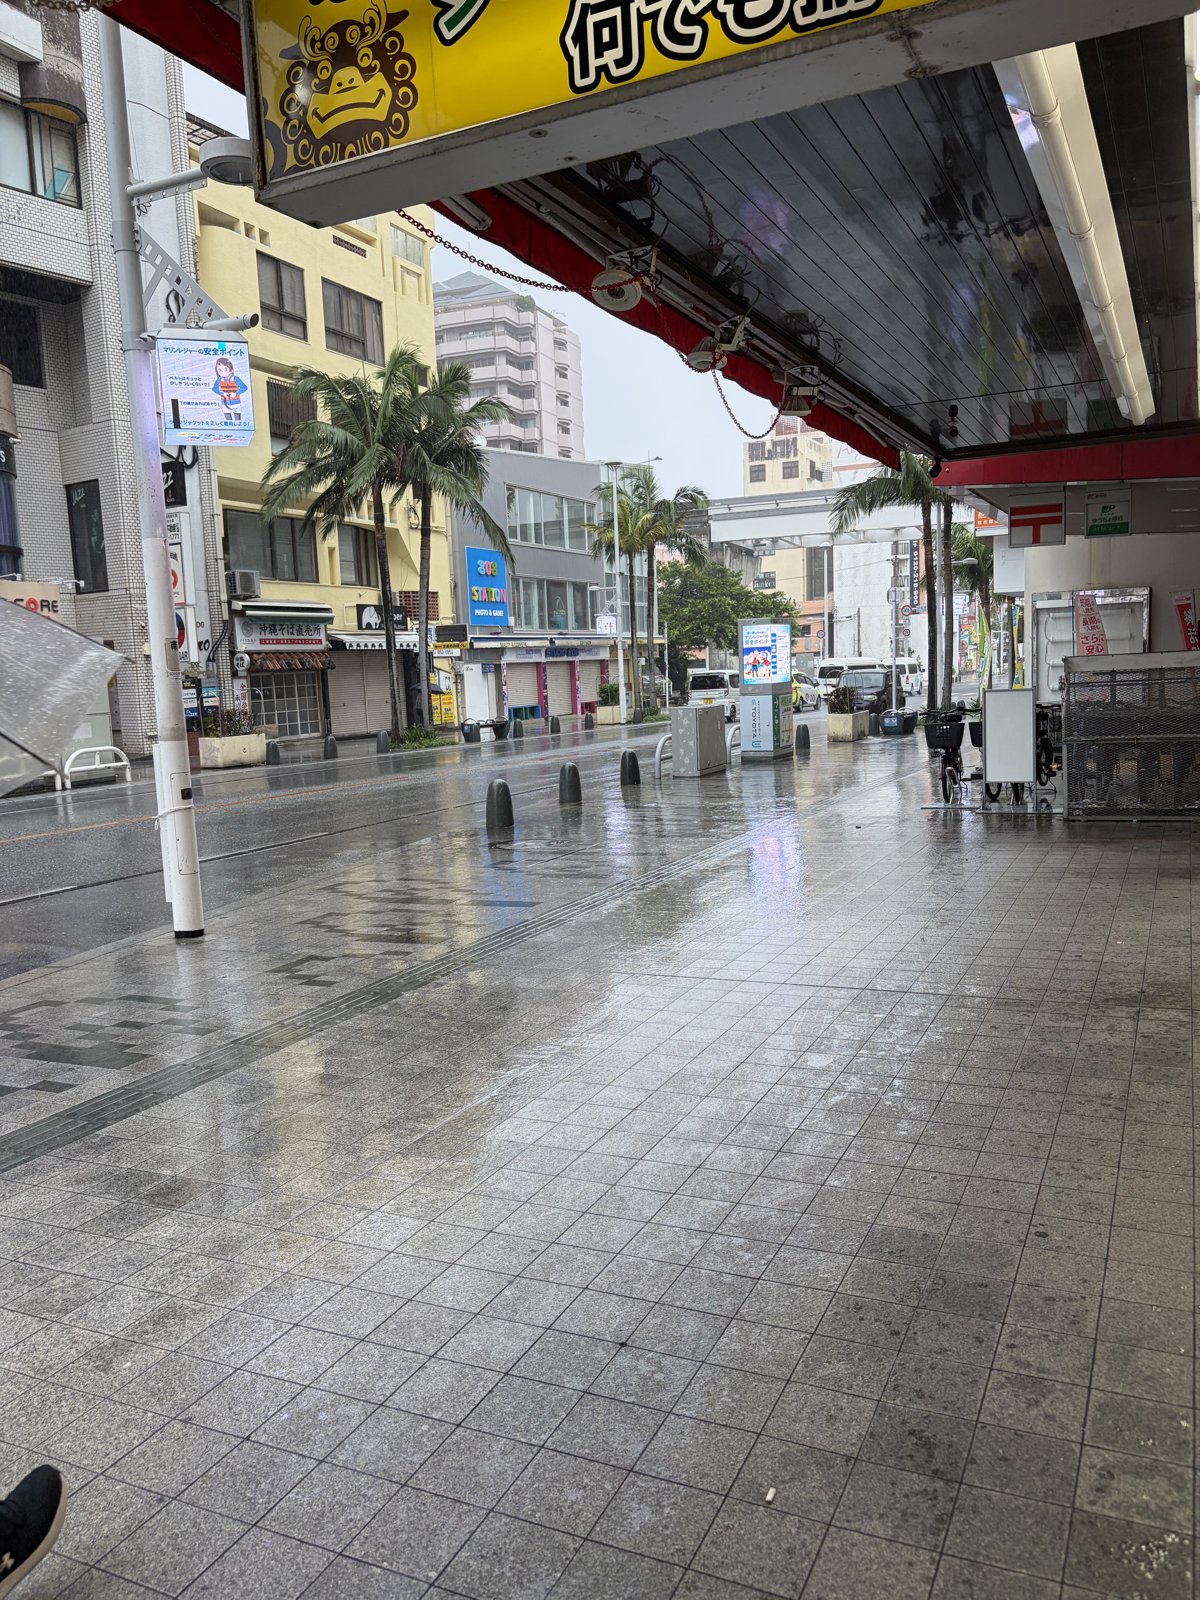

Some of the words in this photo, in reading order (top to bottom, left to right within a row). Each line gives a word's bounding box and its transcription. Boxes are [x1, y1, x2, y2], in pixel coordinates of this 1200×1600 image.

[163, 347, 245, 357] マリンレジャーの安全ポイント
[477, 560, 497, 576] 808
[472, 586, 507, 603] STATION
[14, 598, 59, 613] ORE
[259, 623, 321, 637] 沖縄そば直売所
[1081, 634, 1104, 645] さらに
[1085, 644, 1104, 655] 安心
